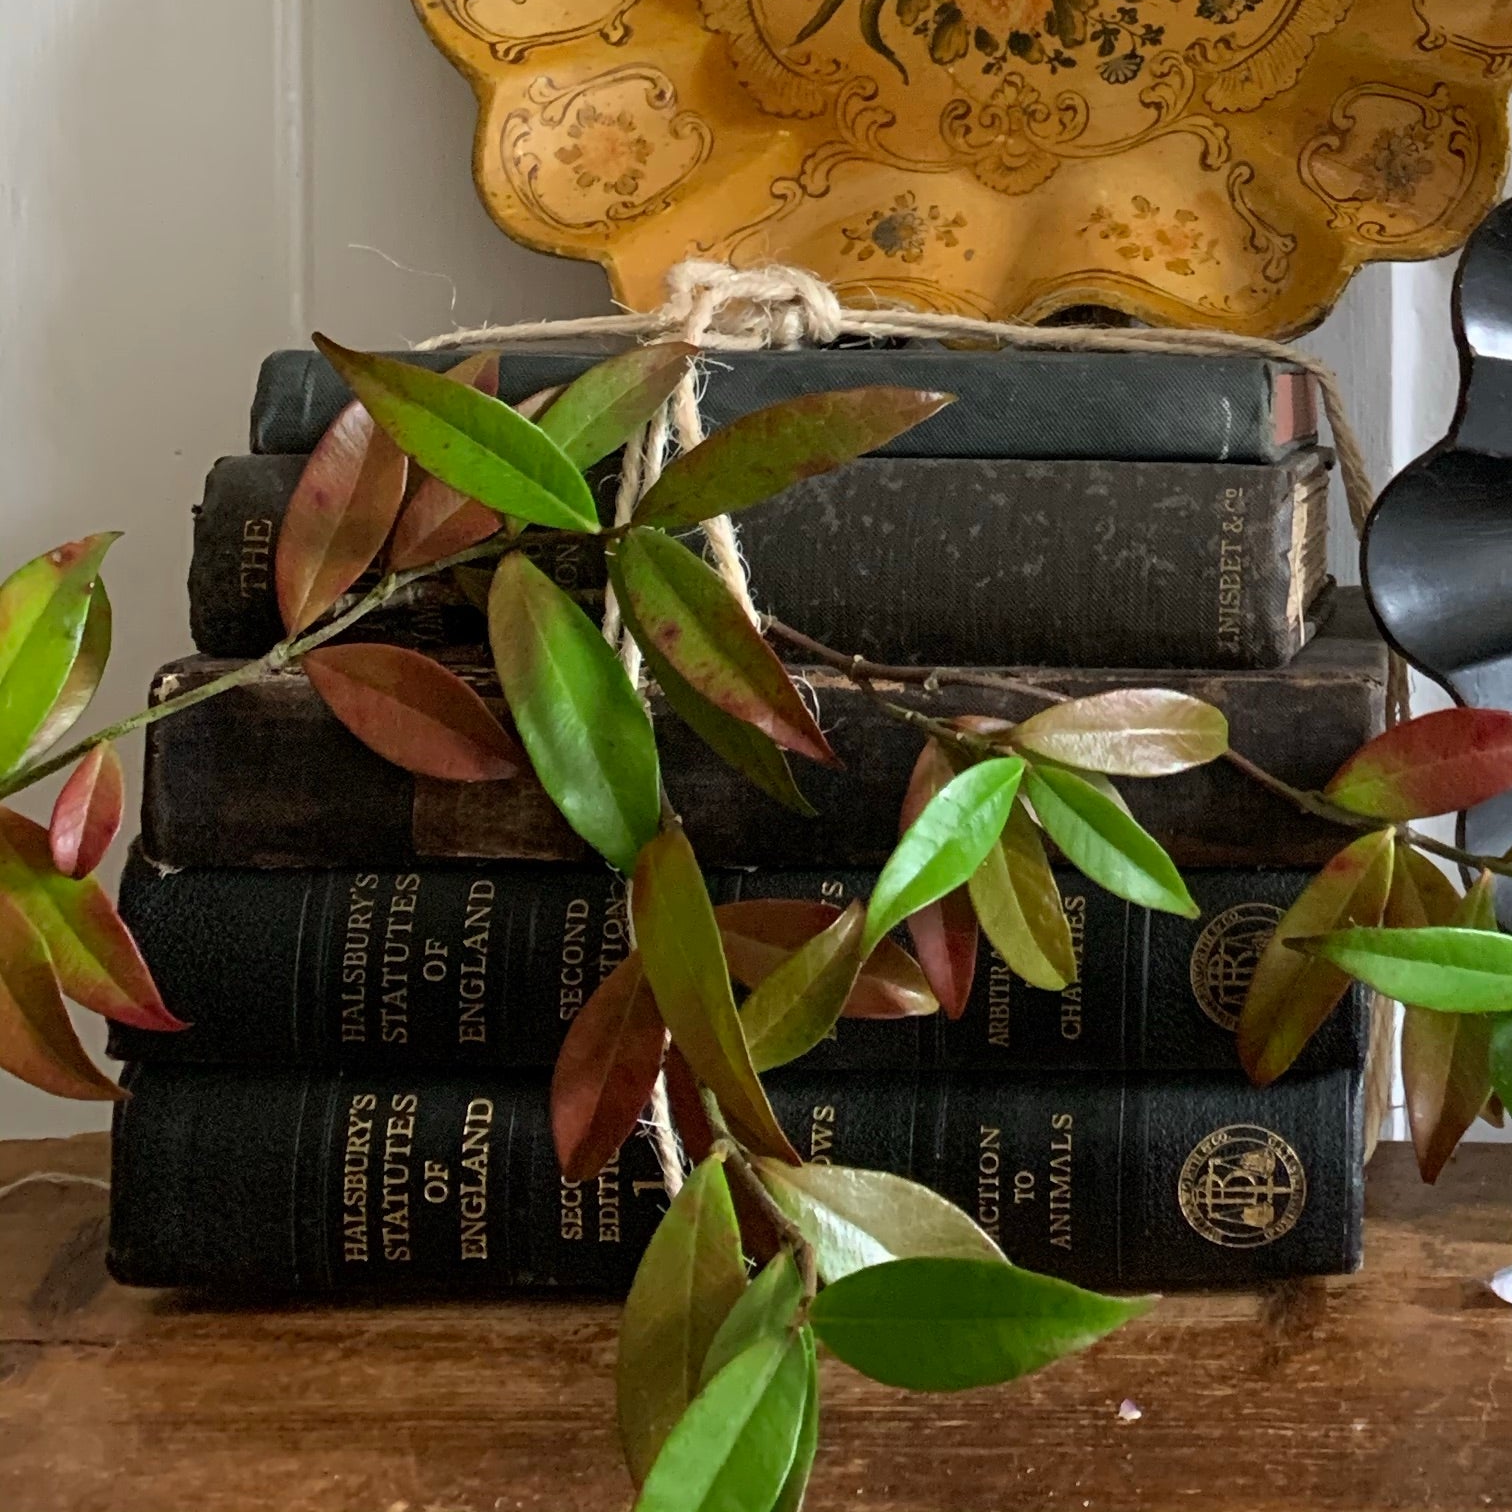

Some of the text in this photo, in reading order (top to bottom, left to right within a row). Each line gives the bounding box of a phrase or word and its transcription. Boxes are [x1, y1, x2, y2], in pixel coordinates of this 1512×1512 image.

[241, 519, 273, 598] THE
[341, 873, 379, 1043] HALSBURY'S
[381, 873, 421, 1044] STATUTES
[422, 938, 448, 982] OF
[459, 879, 496, 1044] ENGLAND
[559, 898, 590, 1022] SECOND
[344, 1093, 377, 1263] HALSBURY'S
[382, 1093, 418, 1262] STATUTES
[424, 1160, 450, 1204] OF
[460, 1097, 494, 1261] ENGLAND
[1013, 1170, 1035, 1205] TO
[1049, 1113, 1074, 1250] ANIMALS
